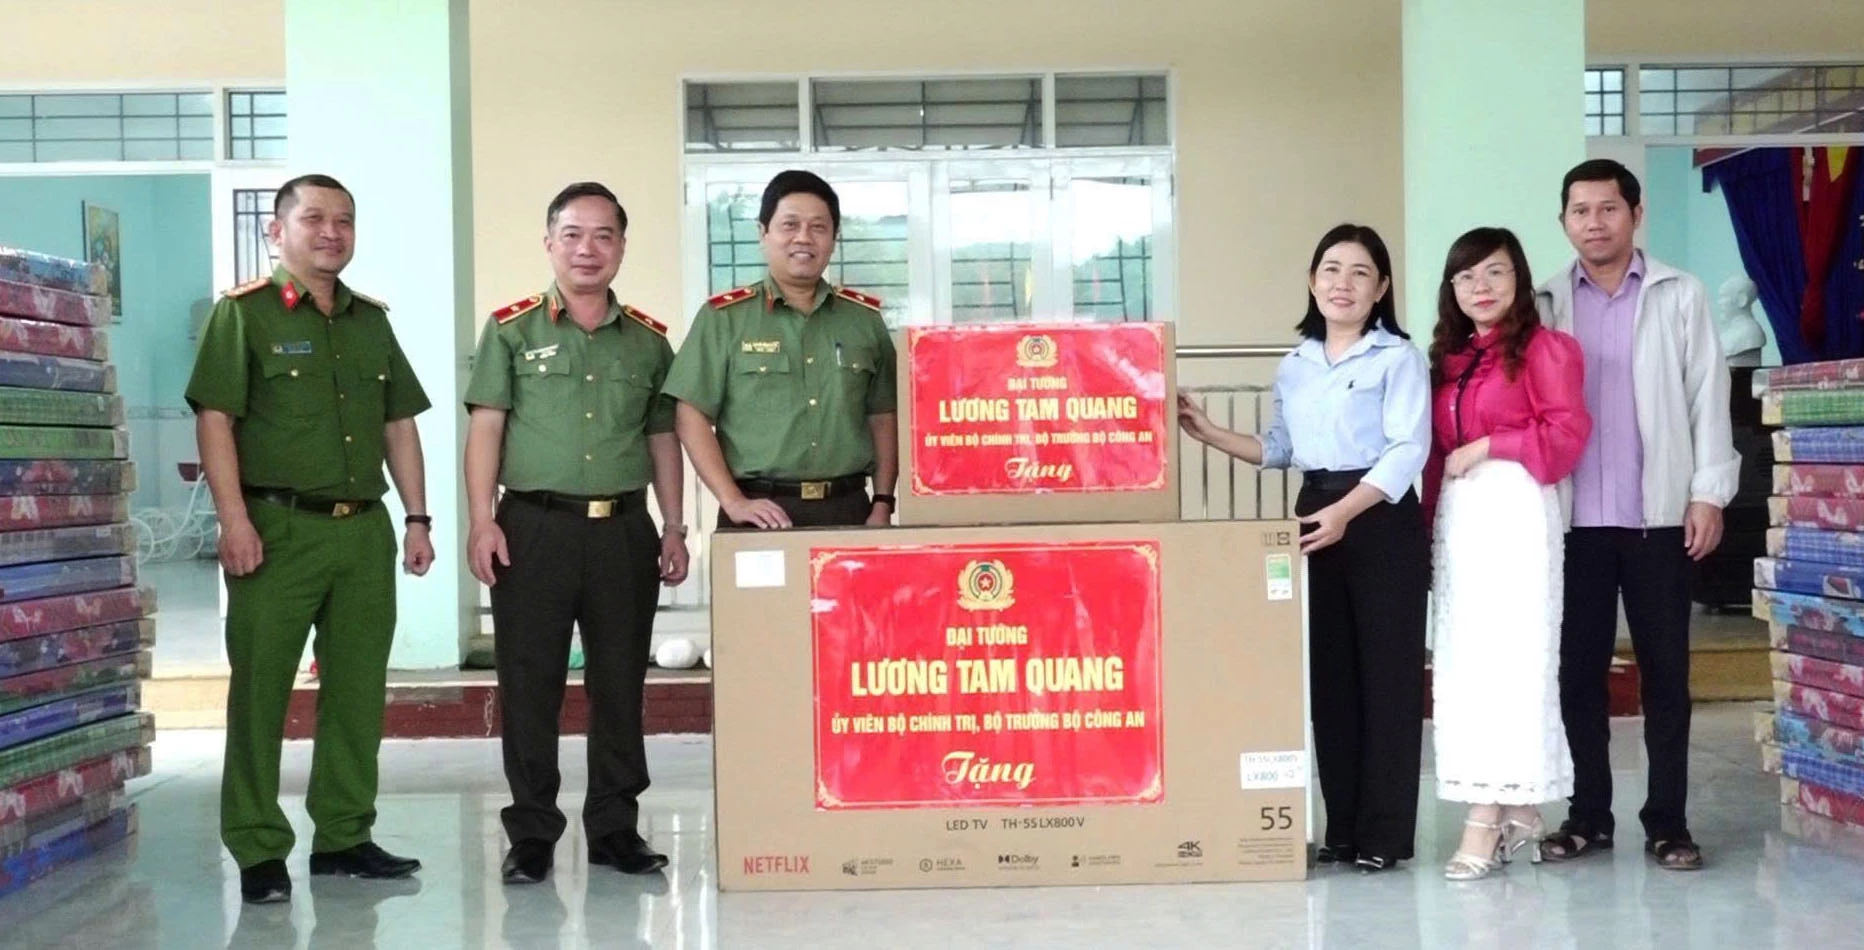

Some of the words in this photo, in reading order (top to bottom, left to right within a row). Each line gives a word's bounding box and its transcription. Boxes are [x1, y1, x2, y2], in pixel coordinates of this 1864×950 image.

[939, 397, 1009, 423] LƯƠNG
[1015, 397, 1059, 421] TAM
[1066, 396, 1138, 422] QUANG
[940, 432, 963, 446] VIÊN
[965, 432, 979, 448] BỘ
[1035, 431, 1049, 447] BỘ
[1092, 430, 1106, 446] BỘ
[1108, 429, 1136, 444] CÔNG
[1138, 430, 1153, 443] AN
[1004, 457, 1072, 482] Tặng
[946, 626, 973, 650] ĐẠI
[976, 622, 1028, 646] TƯỚNG
[851, 658, 948, 697] LƯƠNG
[956, 659, 1016, 694] TAM
[1025, 656, 1124, 696] QUANG
[831, 712, 849, 734] ỦY
[853, 713, 884, 733] VIÊN
[887, 712, 906, 736] BỘ
[909, 712, 952, 732] CHÍNH
[983, 710, 1002, 734] BỘ
[1005, 708, 1059, 730] TRƯỞNG
[1062, 709, 1081, 733] BỘ
[1084, 708, 1121, 729] CÔNG
[1125, 710, 1145, 728] AN
[942, 751, 1035, 789] Tặng
[946, 819, 969, 831] LED
[972, 819, 988, 830] TV
[1261, 806, 1293, 830] 55
[1178, 840, 1201, 850] 4K
[743, 856, 810, 875] NETFLIX
[1011, 855, 1039, 865] Dolby
